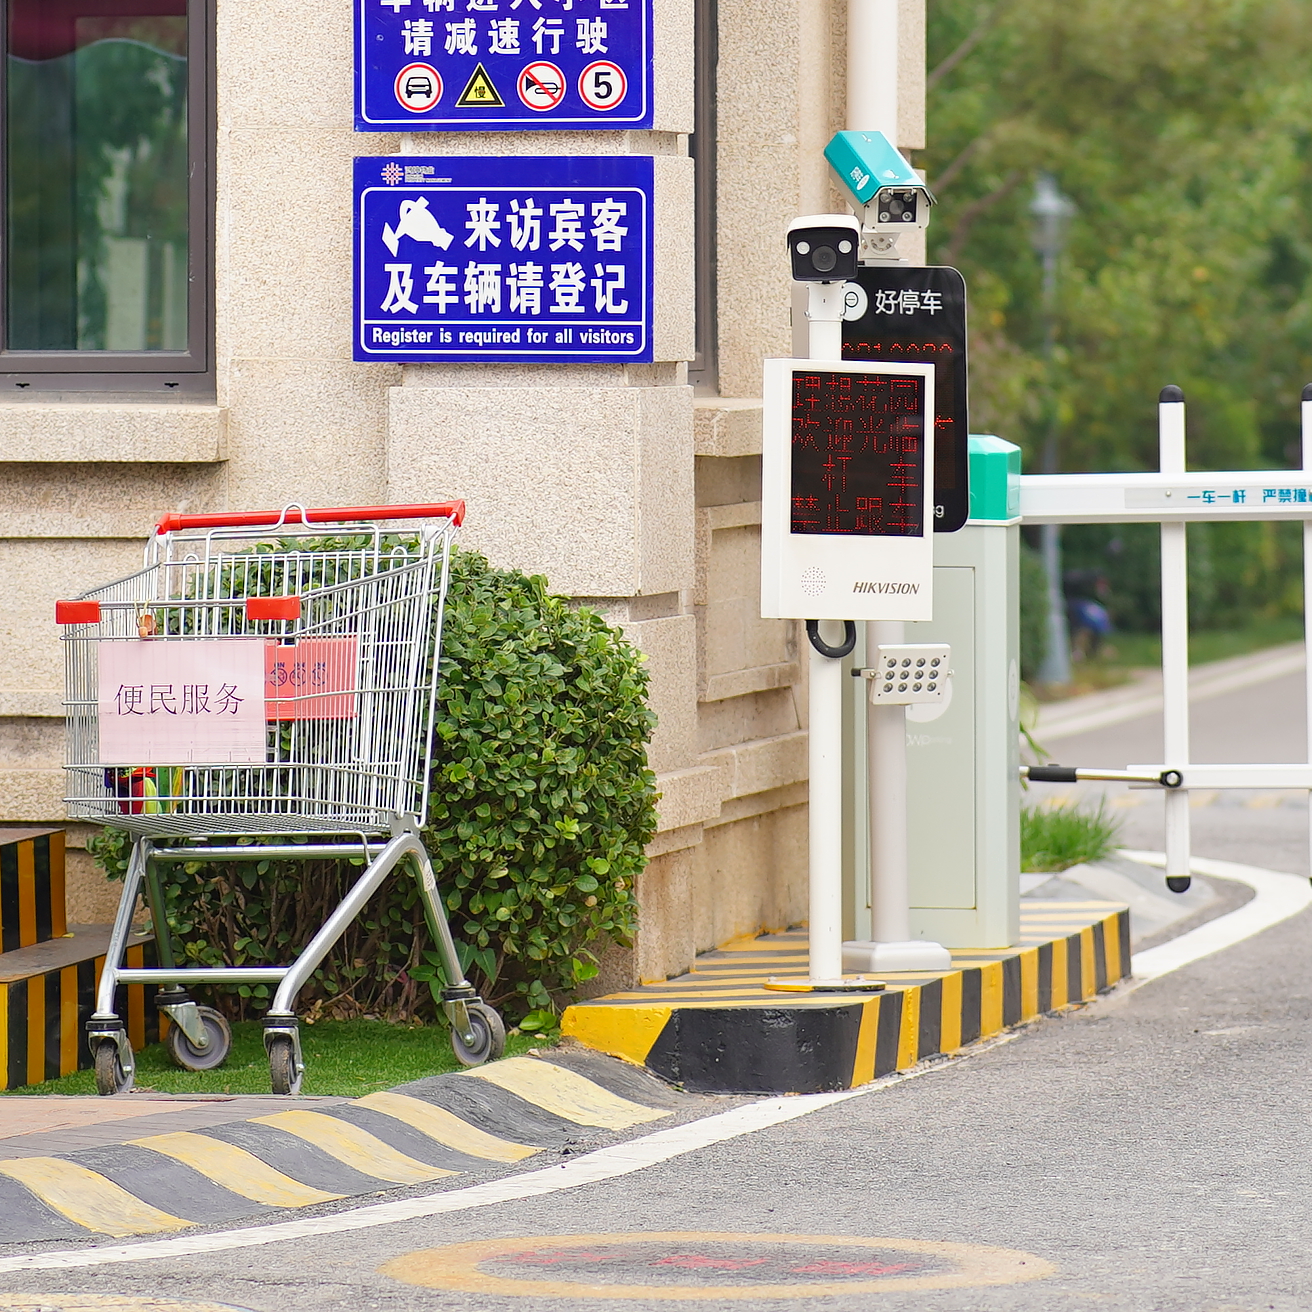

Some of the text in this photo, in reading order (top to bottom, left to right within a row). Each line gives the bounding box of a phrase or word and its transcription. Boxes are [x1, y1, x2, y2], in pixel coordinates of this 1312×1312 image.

[401, 16, 609, 56] 请减速行驶
[593, 72, 612, 99] 5
[464, 196, 629, 253] 来访宾客
[380, 262, 629, 316] 及车辆请登记
[875, 289, 943, 316] 好停车
[372, 327, 634, 346] Register is required for all visitors
[791, 413, 919, 454] 欢迎光临
[790, 493, 919, 533] 禁止跟车
[1187, 489, 1246, 504] 一车一杆
[852, 581, 921, 595] HIKVISION
[114, 682, 245, 716] 便民服务
